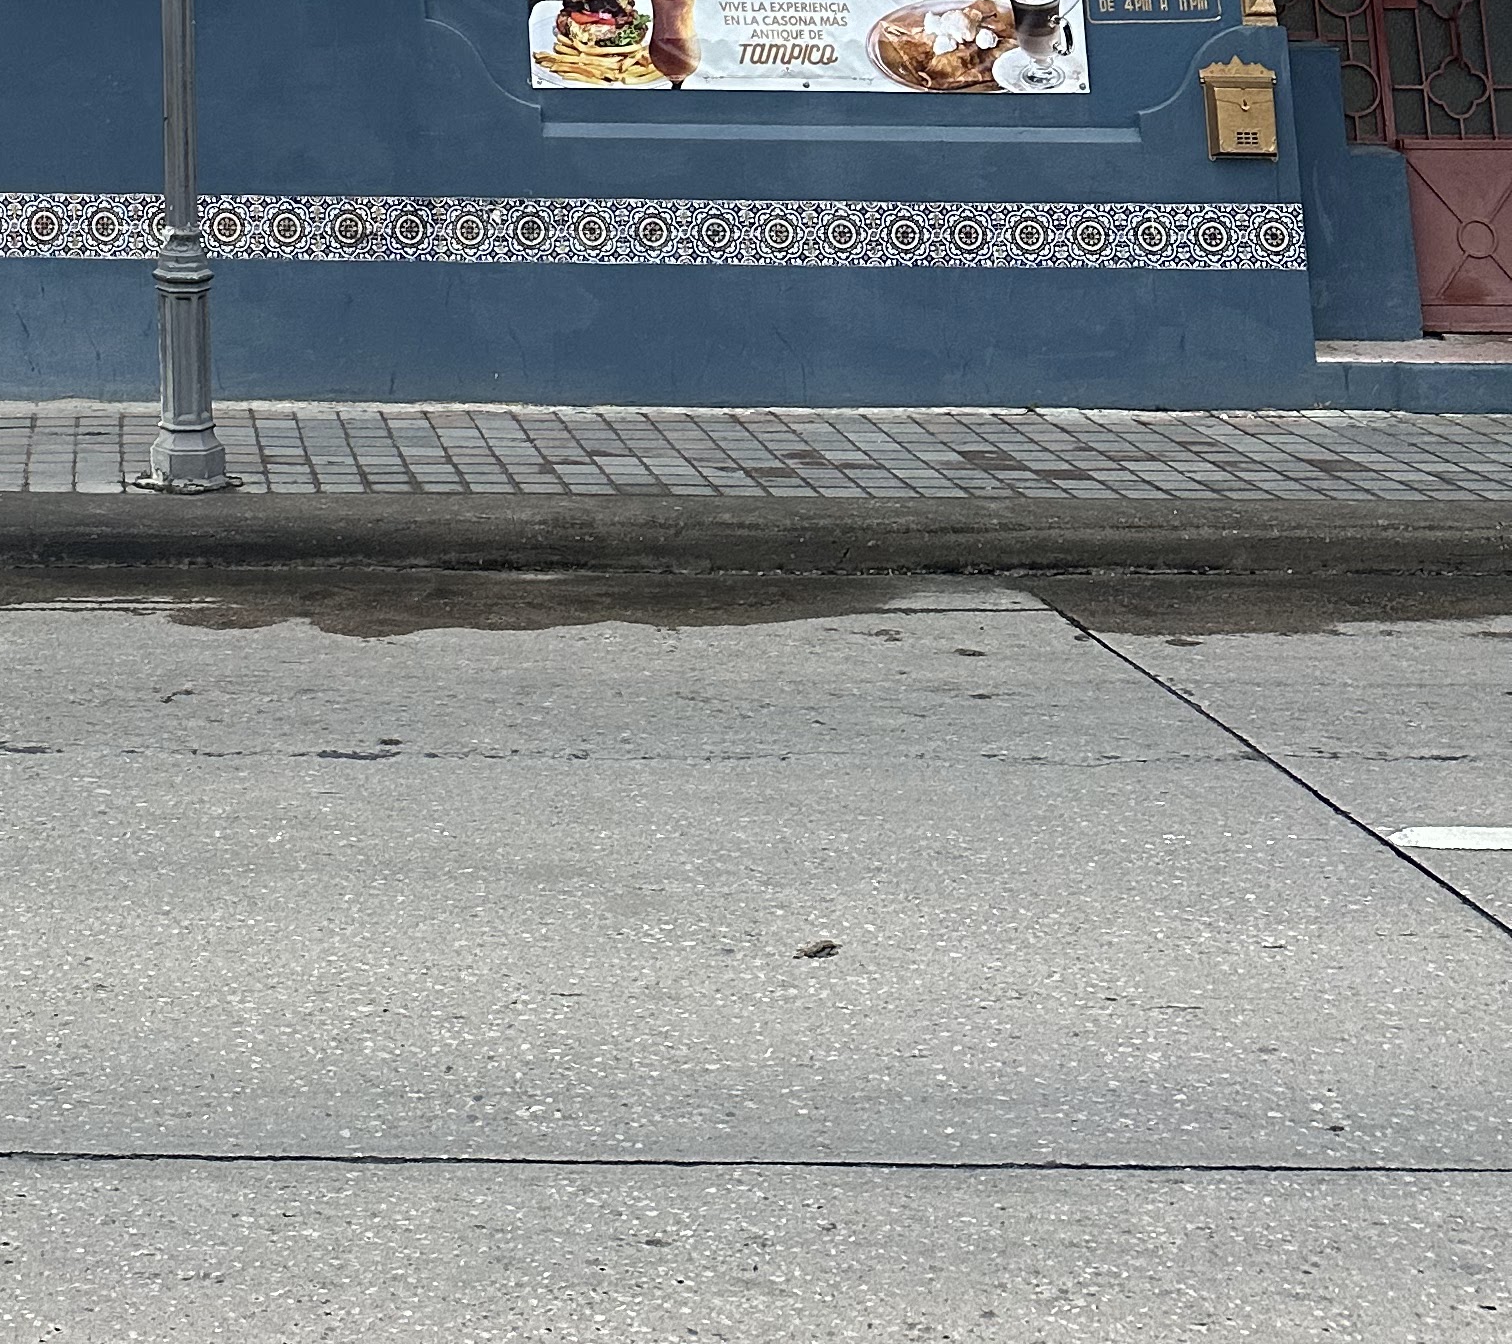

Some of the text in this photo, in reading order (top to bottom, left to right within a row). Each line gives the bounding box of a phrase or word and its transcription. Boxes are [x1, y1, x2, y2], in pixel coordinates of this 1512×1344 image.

[718, 1, 850, 13] VIVE LA EXPERIENCIA
[724, 13, 848, 27] EN LA CASONA MÁS
[750, 28, 824, 42] ANTIQUE DE
